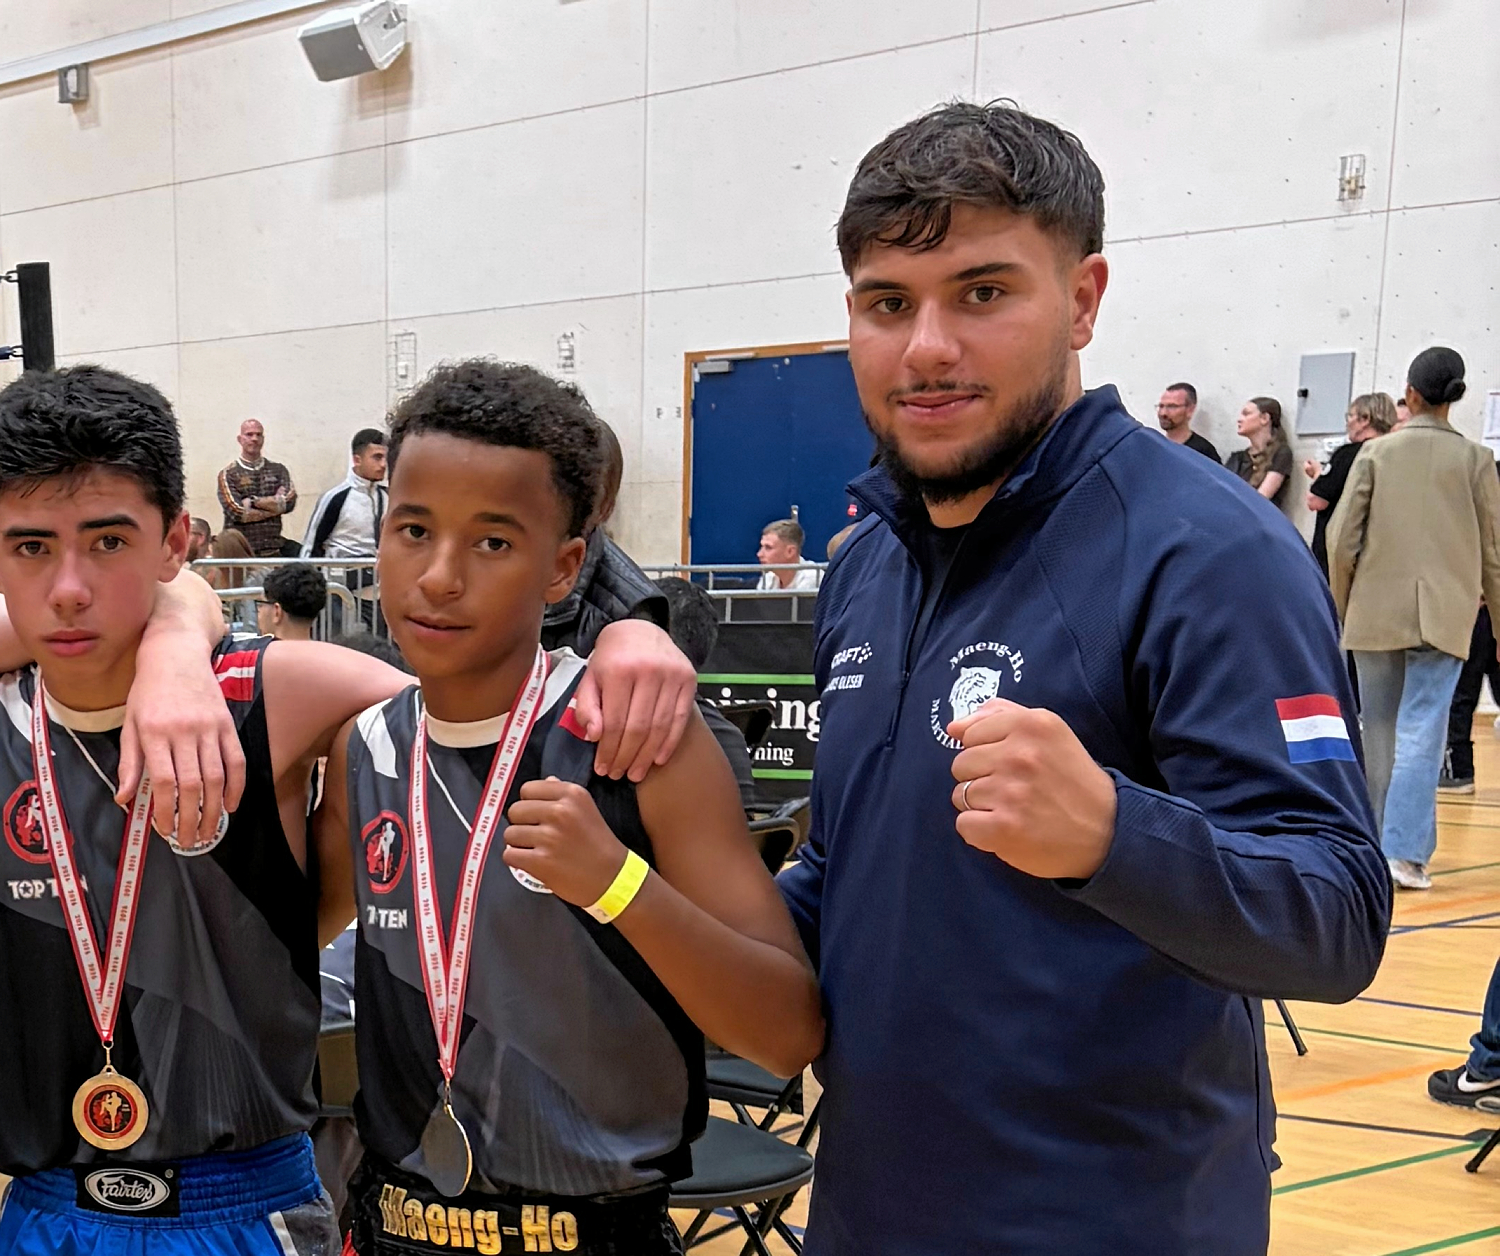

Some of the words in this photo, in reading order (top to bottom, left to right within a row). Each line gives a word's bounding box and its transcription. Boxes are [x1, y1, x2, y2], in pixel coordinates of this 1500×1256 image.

[950, 641, 1024, 683] Maeng-Ho
[516, 709, 528, 728] 2026
[506, 736, 518, 754] 2026
[497, 762, 509, 780] 2026
[488, 789, 499, 807] 2026
[480, 815, 491, 833] 2026
[472, 842, 482, 860] 2026
[7, 879, 46, 900] TOP
[378, 907, 408, 929] TEN
[100, 1175, 154, 1204] Fairtex
[379, 1184, 579, 1256] Maeng-Ho
